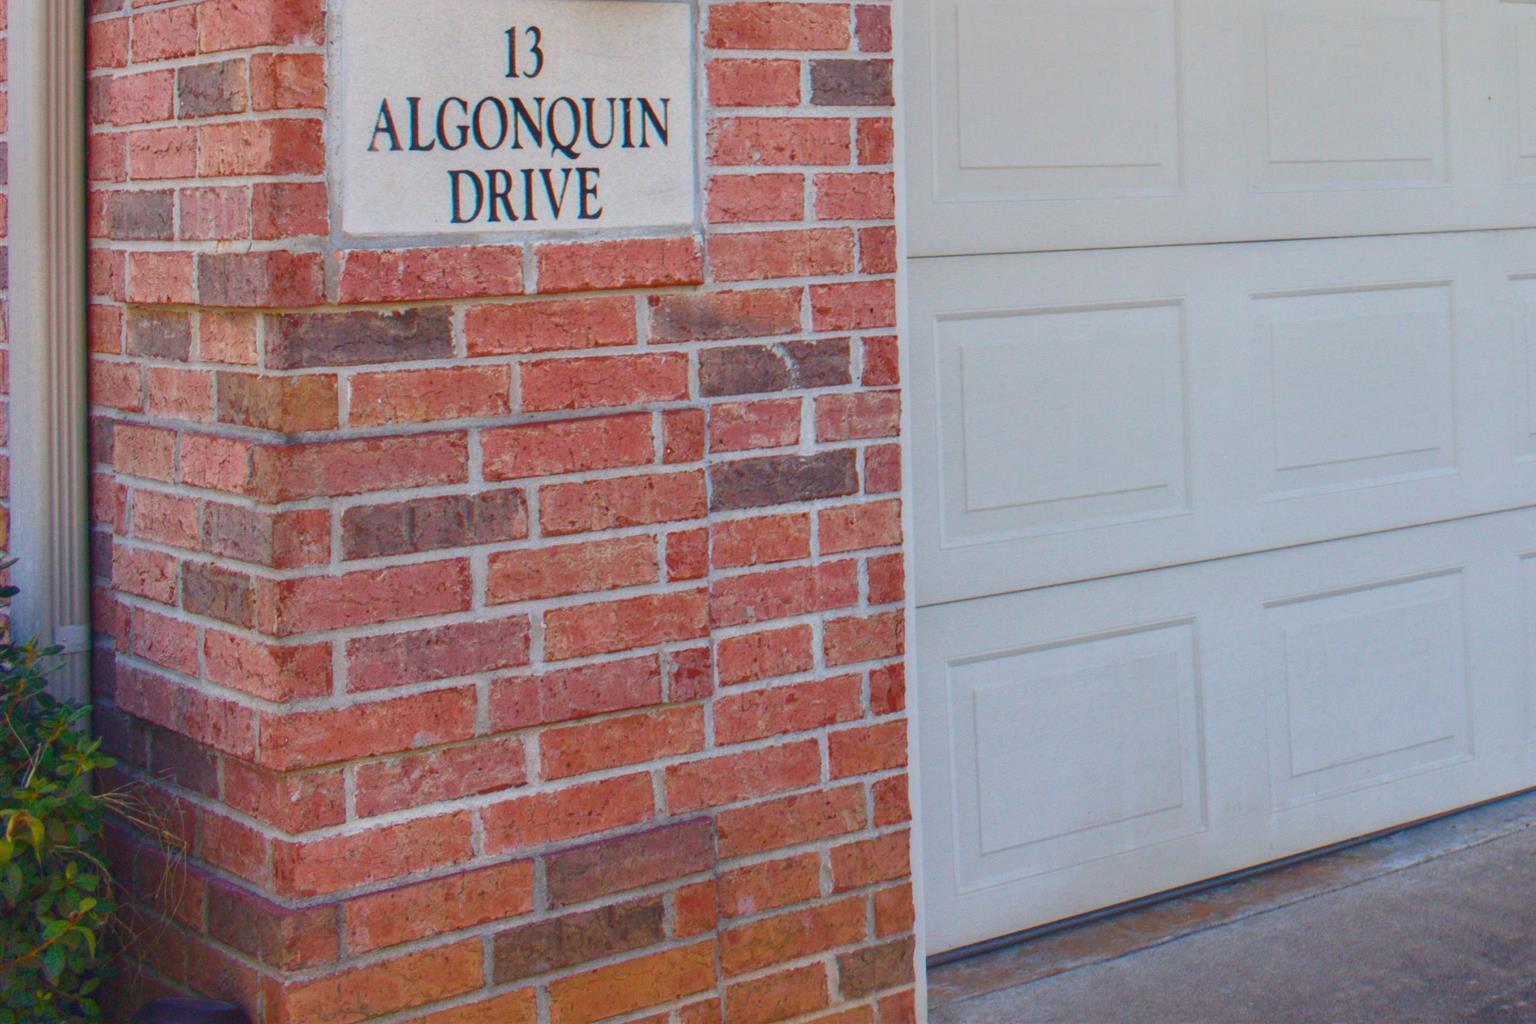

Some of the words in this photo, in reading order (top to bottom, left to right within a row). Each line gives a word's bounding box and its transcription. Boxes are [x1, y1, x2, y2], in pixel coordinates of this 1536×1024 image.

[504, 25, 545, 79] 13
[367, 95, 671, 160] ALGONQUIN
[447, 166, 603, 224] DRIVE
